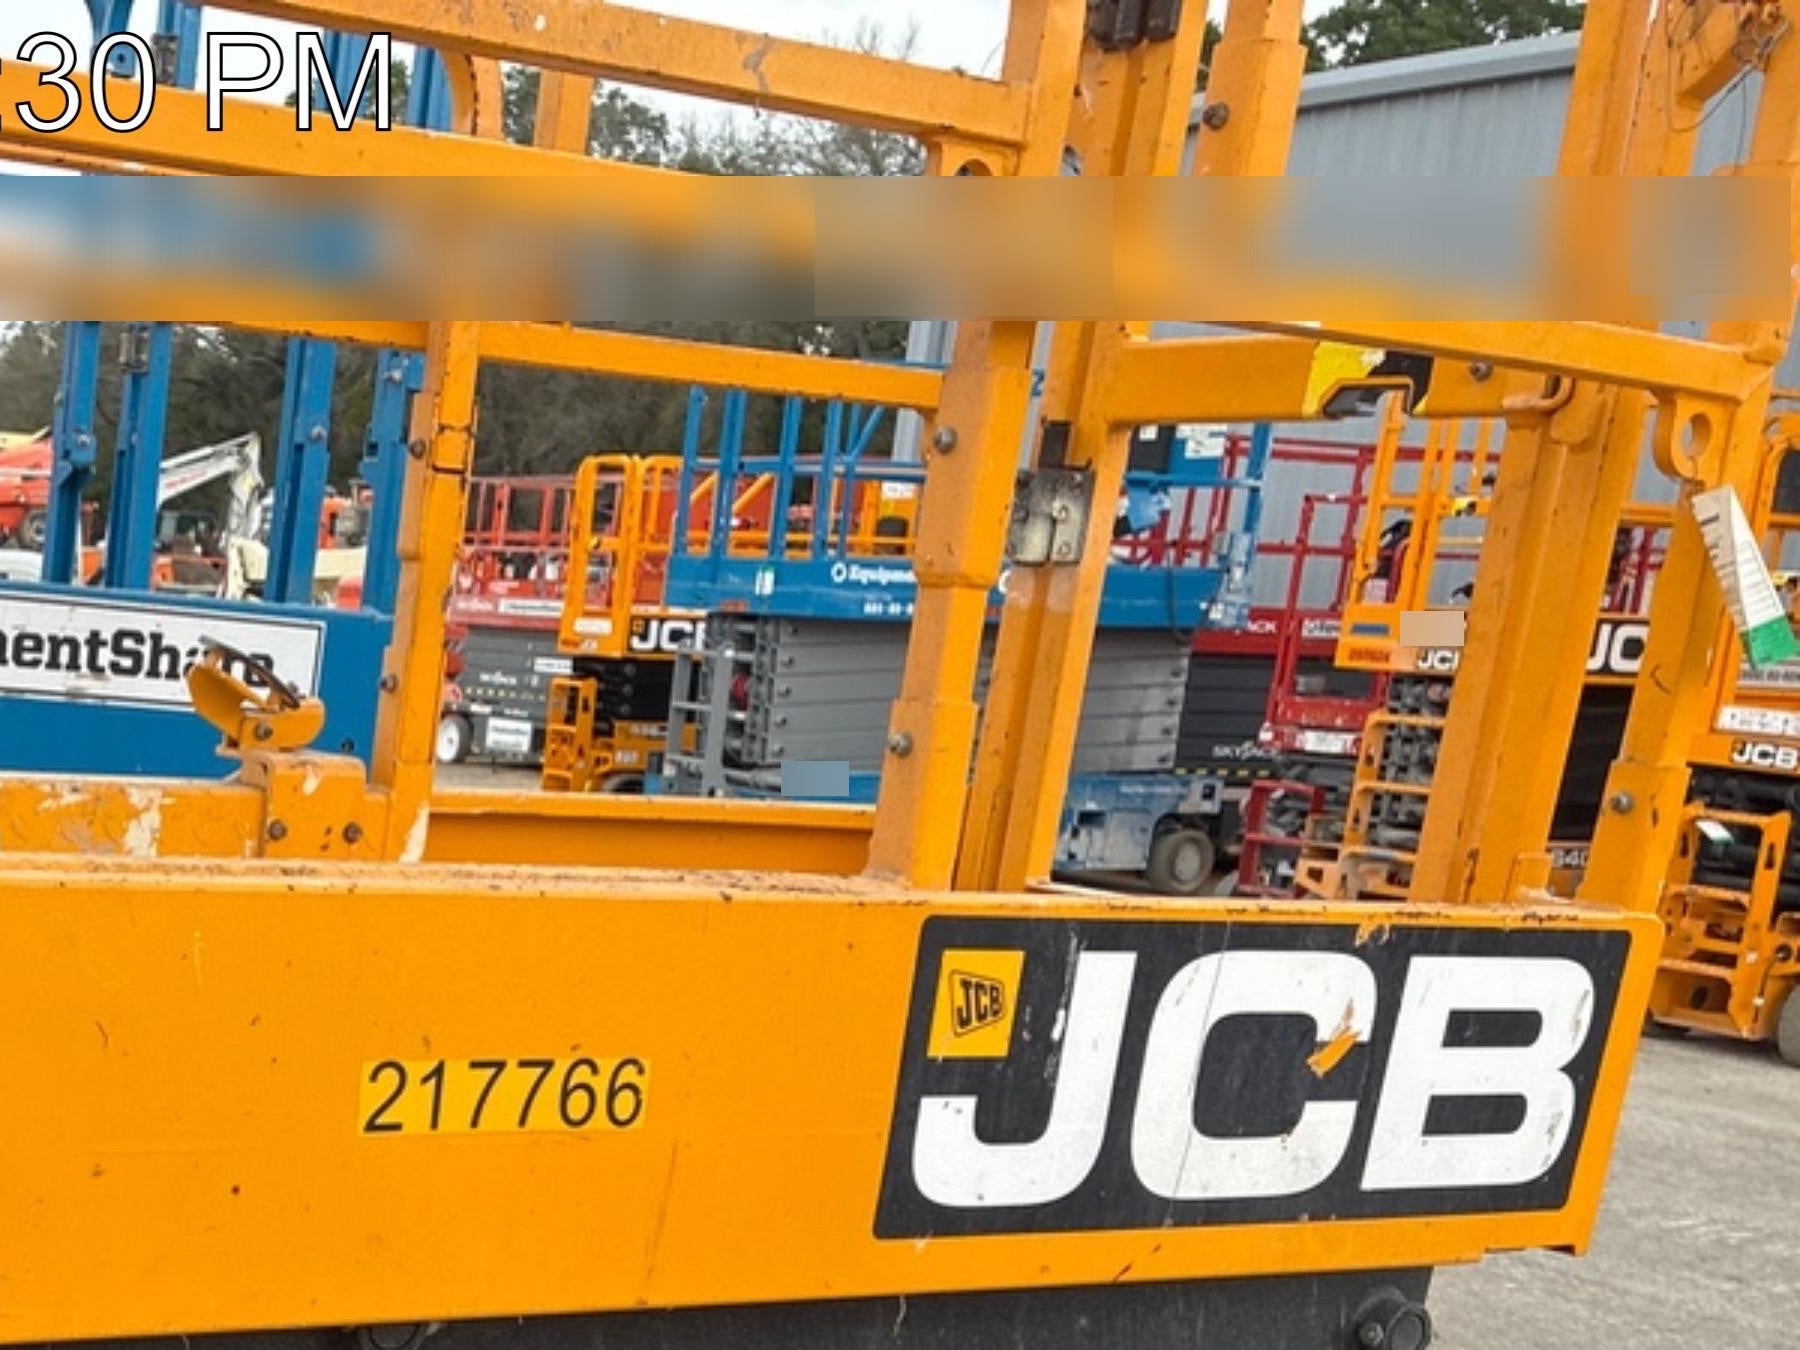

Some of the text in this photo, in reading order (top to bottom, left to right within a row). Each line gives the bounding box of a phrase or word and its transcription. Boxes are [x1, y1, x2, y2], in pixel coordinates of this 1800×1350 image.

[630, 620, 706, 650] JC
[1587, 624, 1650, 671] JC
[1416, 651, 1459, 669] JC
[1733, 743, 1799, 769] JCB
[955, 971, 1004, 1029] JCB
[363, 1058, 645, 1132] 217766
[911, 950, 1595, 1209] JCB
